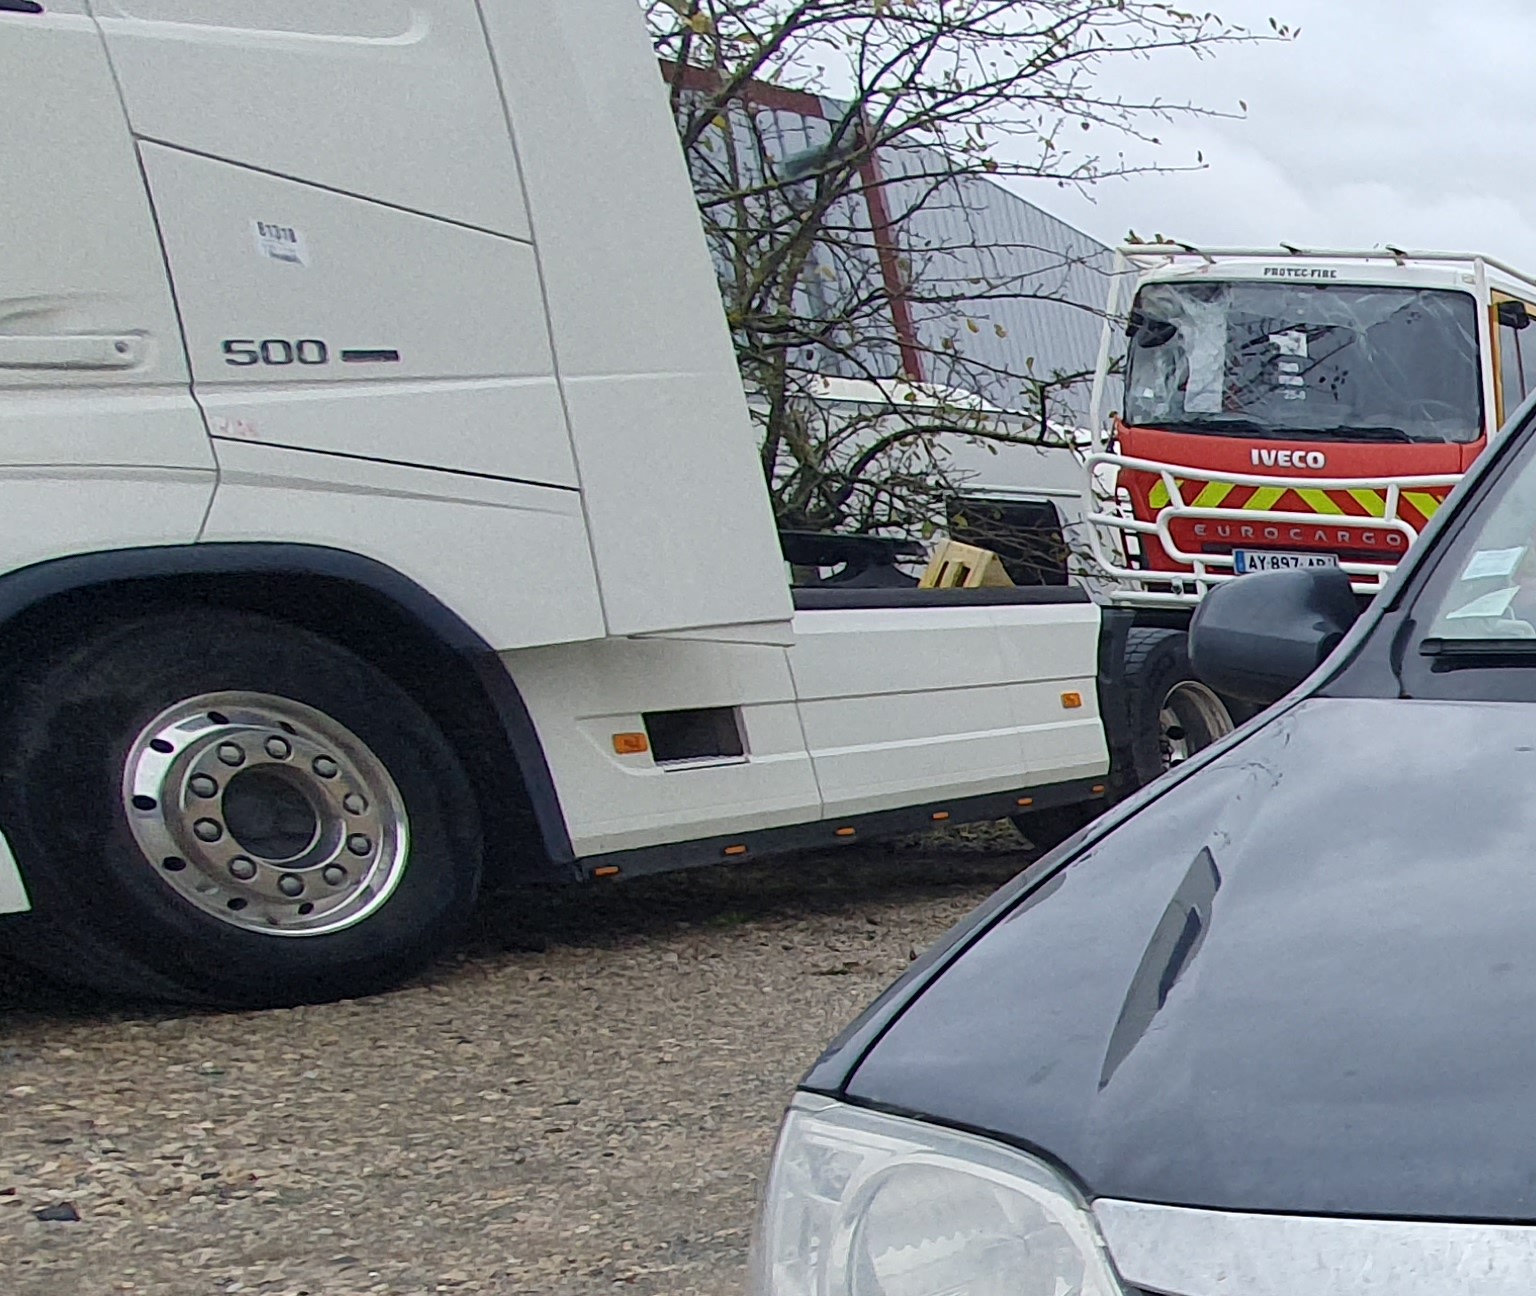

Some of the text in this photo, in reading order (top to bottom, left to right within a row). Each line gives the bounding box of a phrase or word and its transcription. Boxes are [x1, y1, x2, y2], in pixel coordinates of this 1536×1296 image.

[221, 339, 329, 366] 500
[1250, 448, 1326, 469] IVECO
[1194, 523, 1401, 546] EUROCARGO
